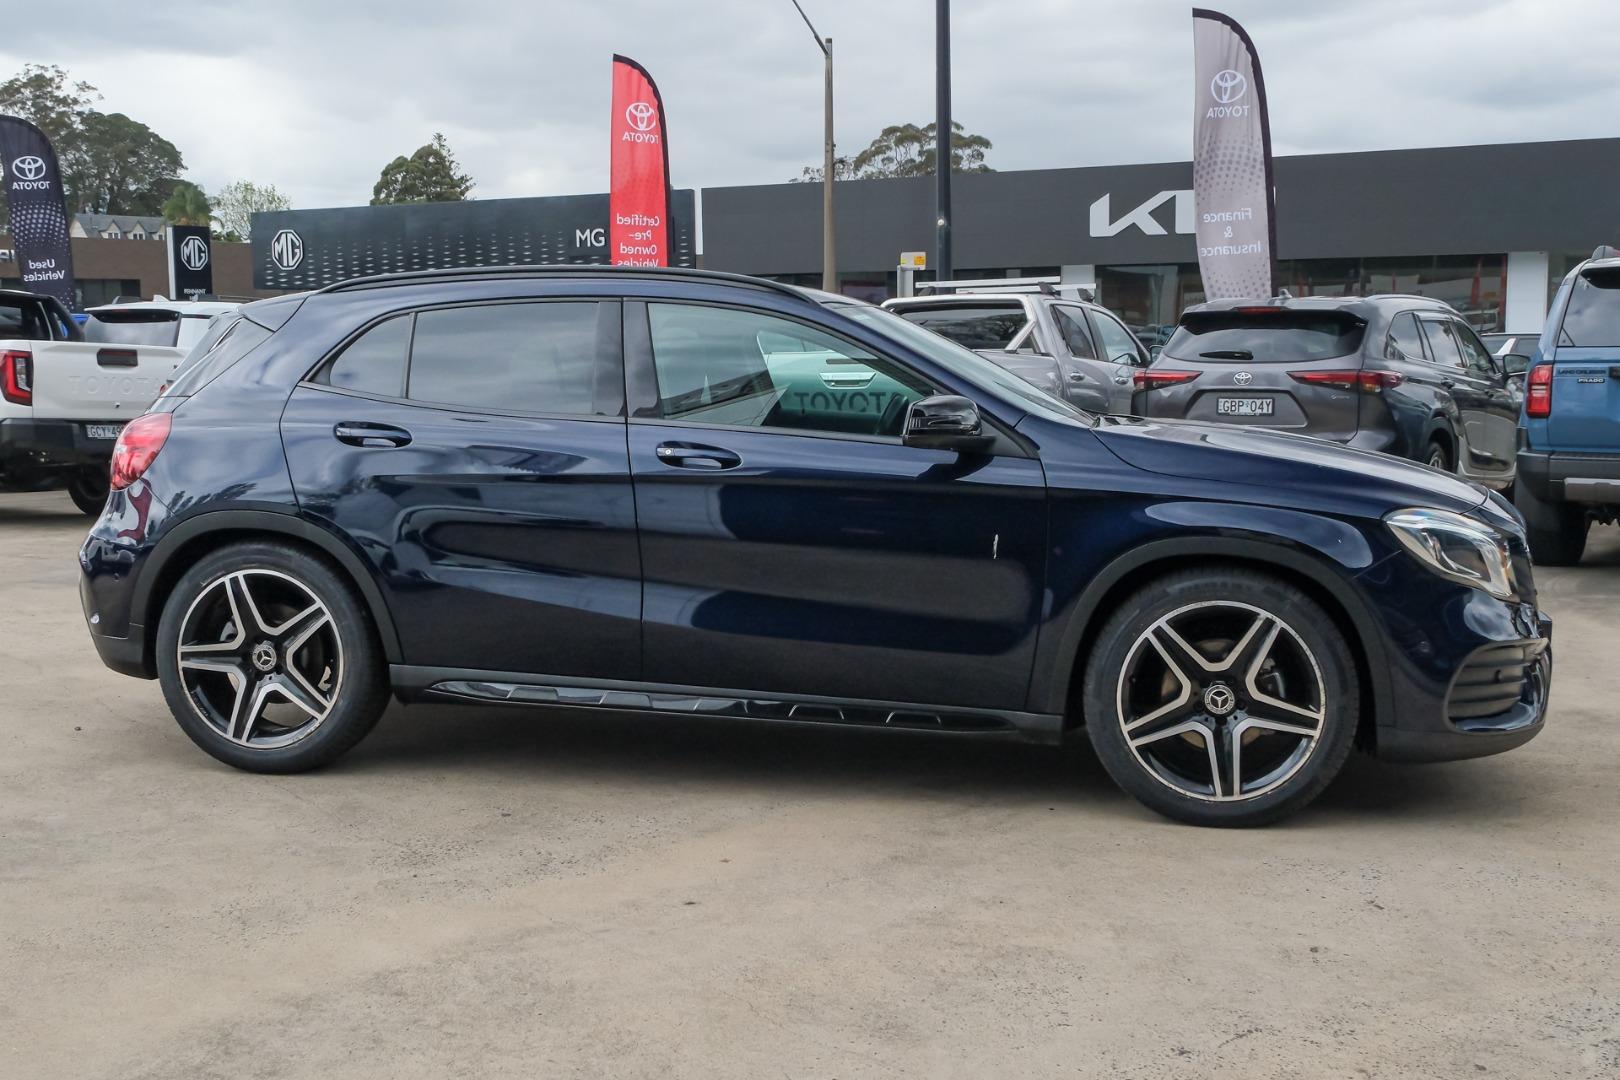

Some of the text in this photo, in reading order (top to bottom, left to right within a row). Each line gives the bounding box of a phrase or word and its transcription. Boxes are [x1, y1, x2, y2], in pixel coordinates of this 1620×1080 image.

[273, 231, 302, 269] MG
[575, 228, 606, 247] MG
[182, 238, 207, 269] MG
[794, 391, 890, 414] TOYOT
